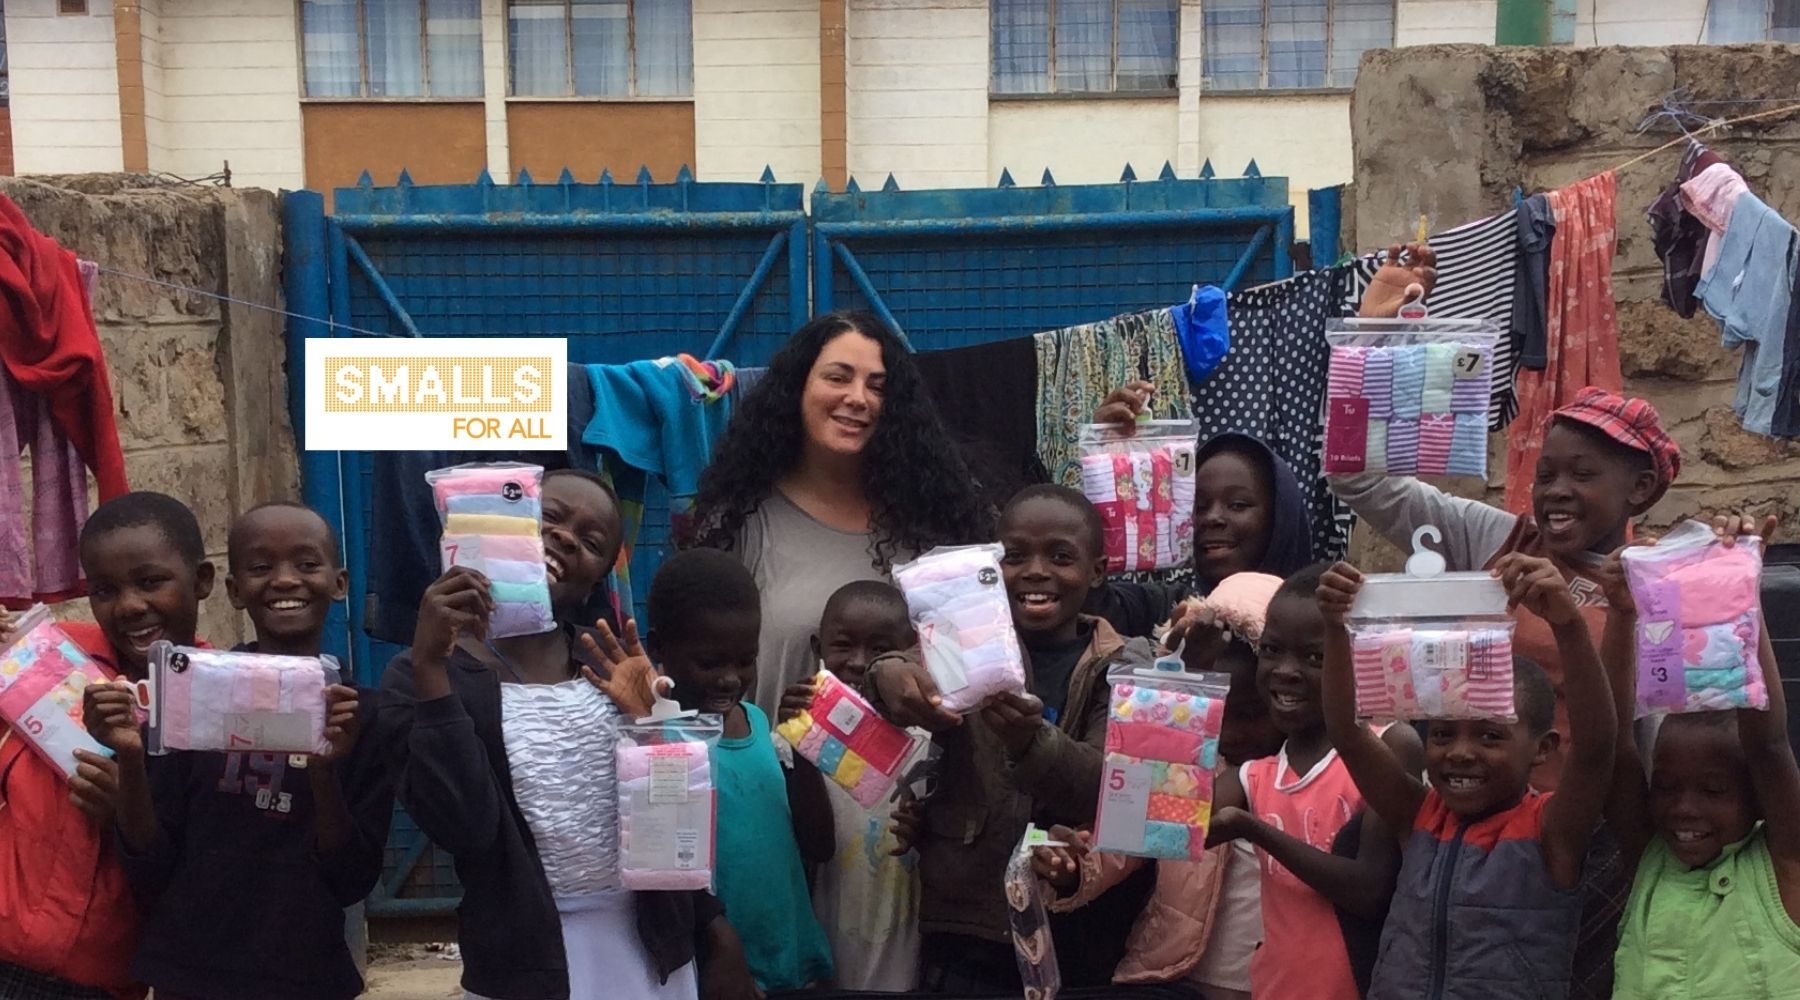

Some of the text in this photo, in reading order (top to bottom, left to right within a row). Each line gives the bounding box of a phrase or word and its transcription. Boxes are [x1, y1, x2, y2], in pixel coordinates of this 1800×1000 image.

[1456, 353, 1480, 373] £7
[1175, 453, 1190, 471] £7
[445, 544, 459, 565] 7
[1651, 667, 1668, 682] £3
[23, 715, 44, 735] 5
[1109, 768, 1126, 791] 5
